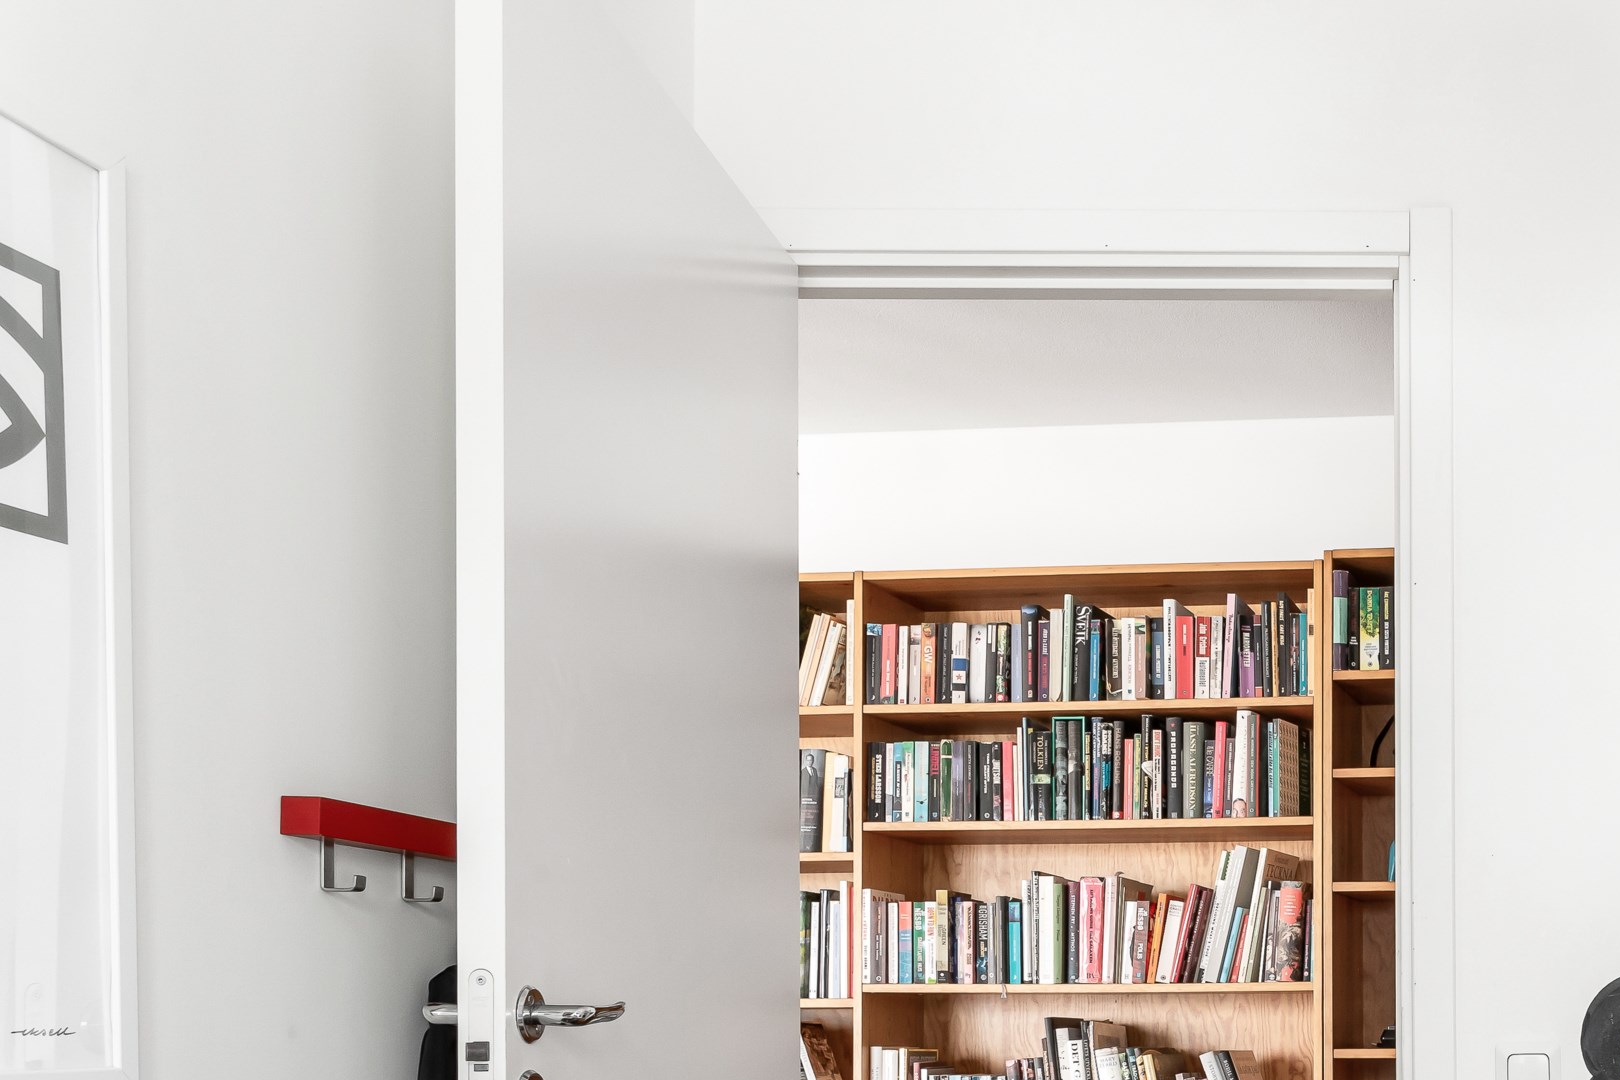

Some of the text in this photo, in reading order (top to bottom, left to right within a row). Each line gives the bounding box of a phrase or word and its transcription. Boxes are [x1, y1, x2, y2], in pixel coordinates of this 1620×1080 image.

[924, 645, 934, 664] GW
[1036, 735, 1044, 770] TOLKIEN
[1188, 724, 1197, 811] HASSE ALFREDSON
[978, 909, 988, 941] GRISHAM
[1136, 942, 1144, 960] POLIS
[1070, 1042, 1081, 1065] DET
